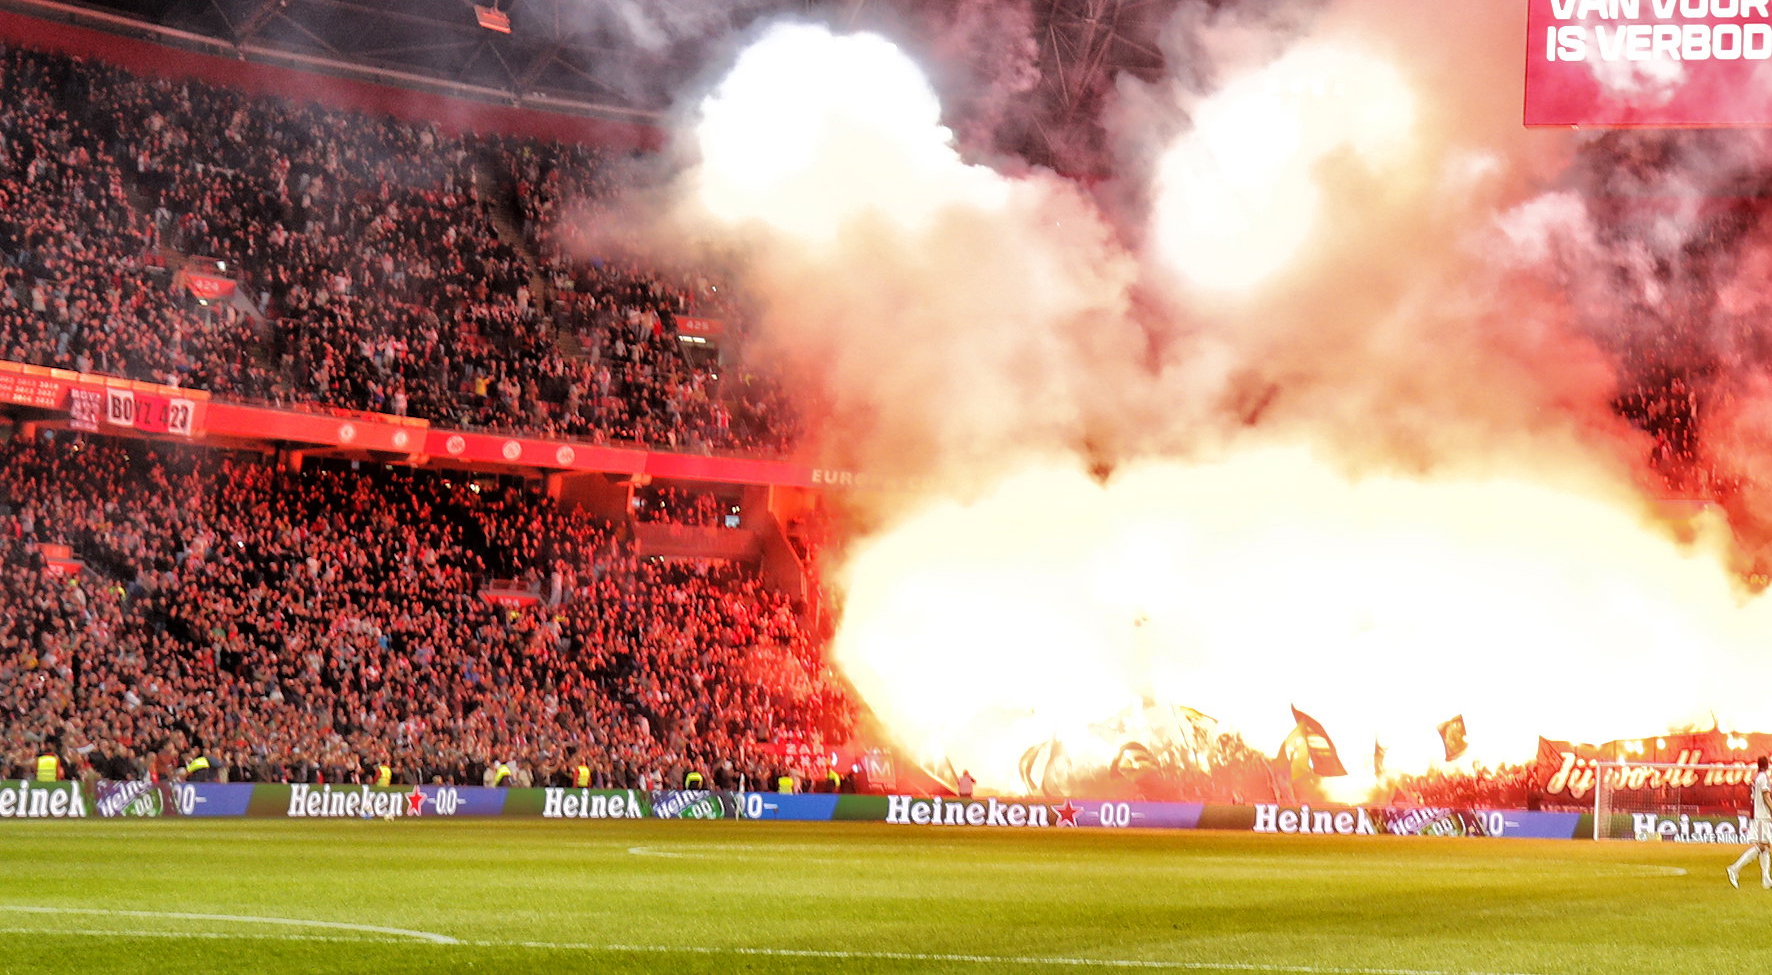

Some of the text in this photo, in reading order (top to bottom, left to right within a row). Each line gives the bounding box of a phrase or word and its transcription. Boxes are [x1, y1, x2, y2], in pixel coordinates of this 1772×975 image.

[1546, 26, 1586, 62] IS
[112, 394, 152, 424] BOYZ
[288, 783, 402, 818] Heineken
[886, 795, 1049, 826] Heineken
